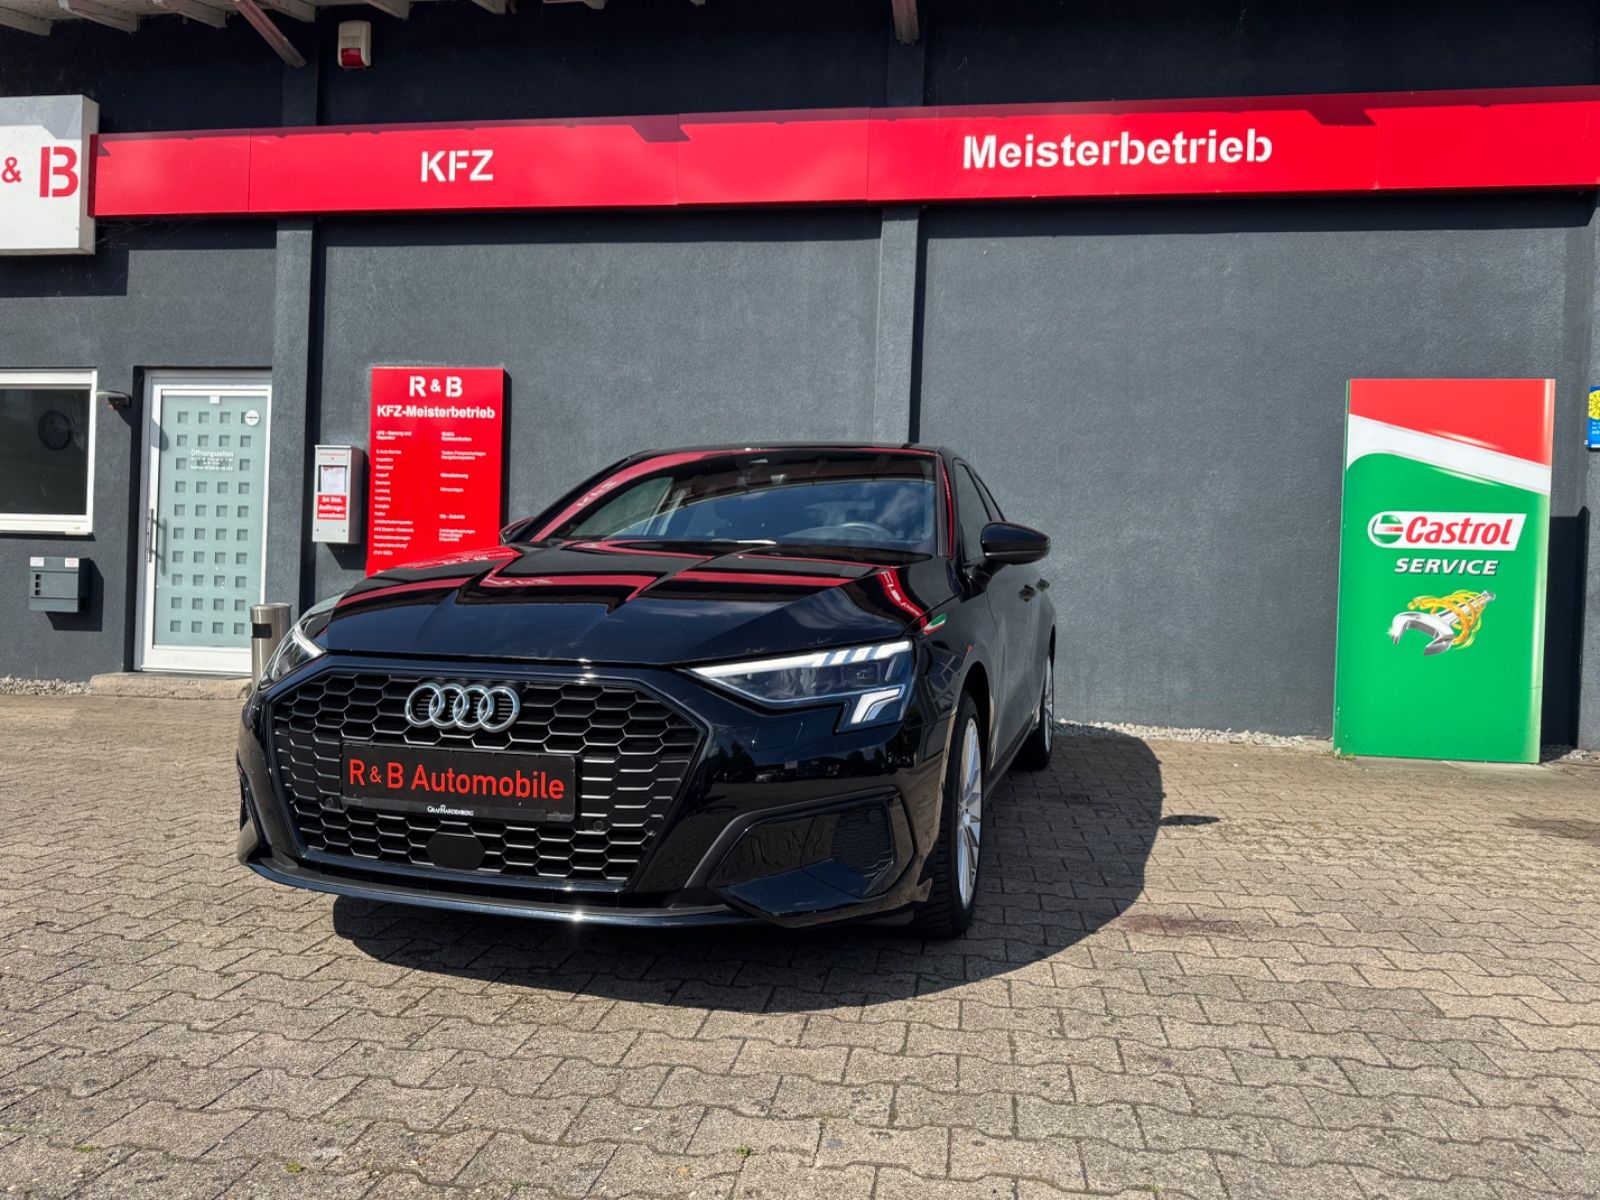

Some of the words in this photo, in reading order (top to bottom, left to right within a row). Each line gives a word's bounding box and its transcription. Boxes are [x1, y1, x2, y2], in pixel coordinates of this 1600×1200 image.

[1, 156, 22, 184] &
[39, 145, 79, 198] B
[419, 149, 494, 184] KFZ
[962, 128, 1274, 170] Meisterbetrieb
[409, 375, 427, 398] R
[430, 378, 442, 393] &
[445, 375, 463, 398] B
[376, 404, 496, 420] KFZ-Meisterbetrieb
[1405, 515, 1514, 546] Castrol
[1394, 557, 1499, 577] SERVICE
[349, 757, 366, 786] R
[369, 765, 382, 784] &
[386, 762, 404, 789] B
[410, 763, 566, 800] Automobile
